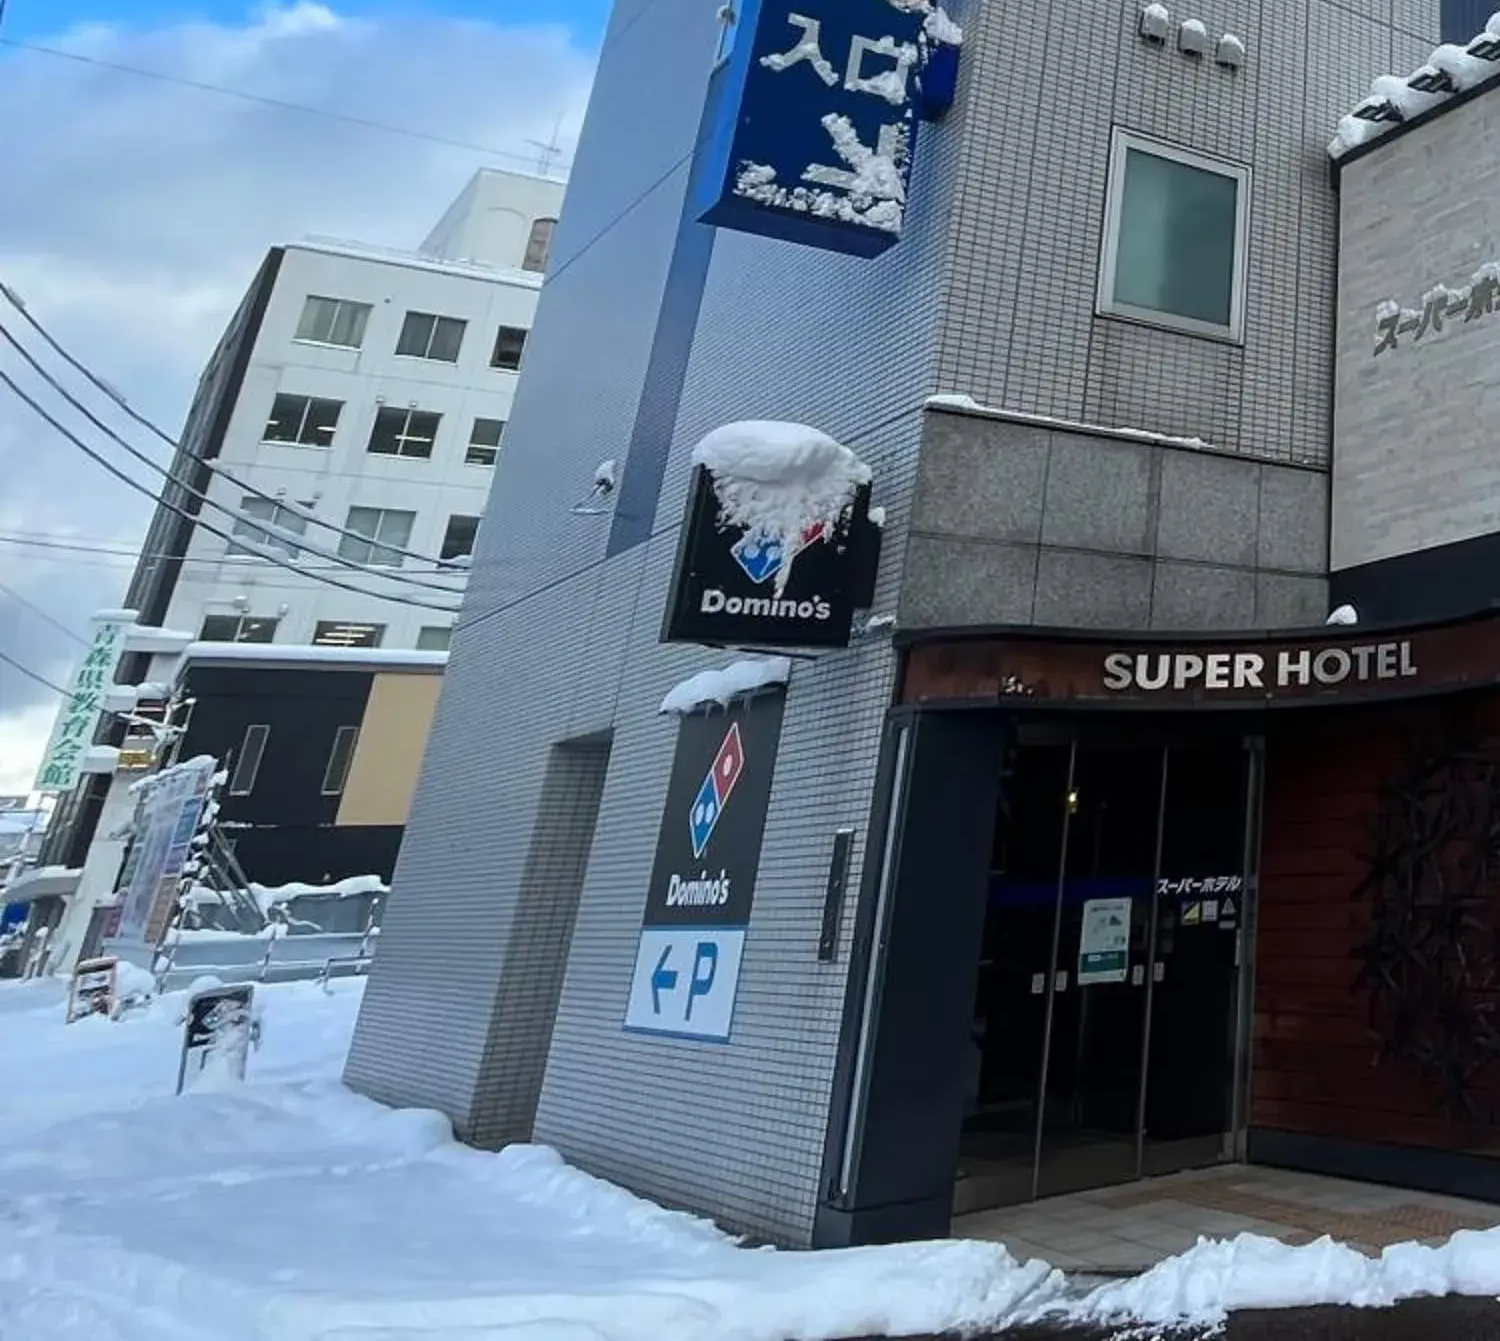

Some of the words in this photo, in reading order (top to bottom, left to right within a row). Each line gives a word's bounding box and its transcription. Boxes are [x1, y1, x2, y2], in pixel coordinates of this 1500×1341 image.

[758, 11, 919, 106] 入口
[700, 588, 833, 620] Domino's
[1103, 652, 1266, 690] SUPER
[1276, 641, 1418, 687] HOTEL
[665, 868, 732, 907] Domino's
[1156, 876, 1243, 895] スーパーホテル
[683, 941, 729, 1022] P
